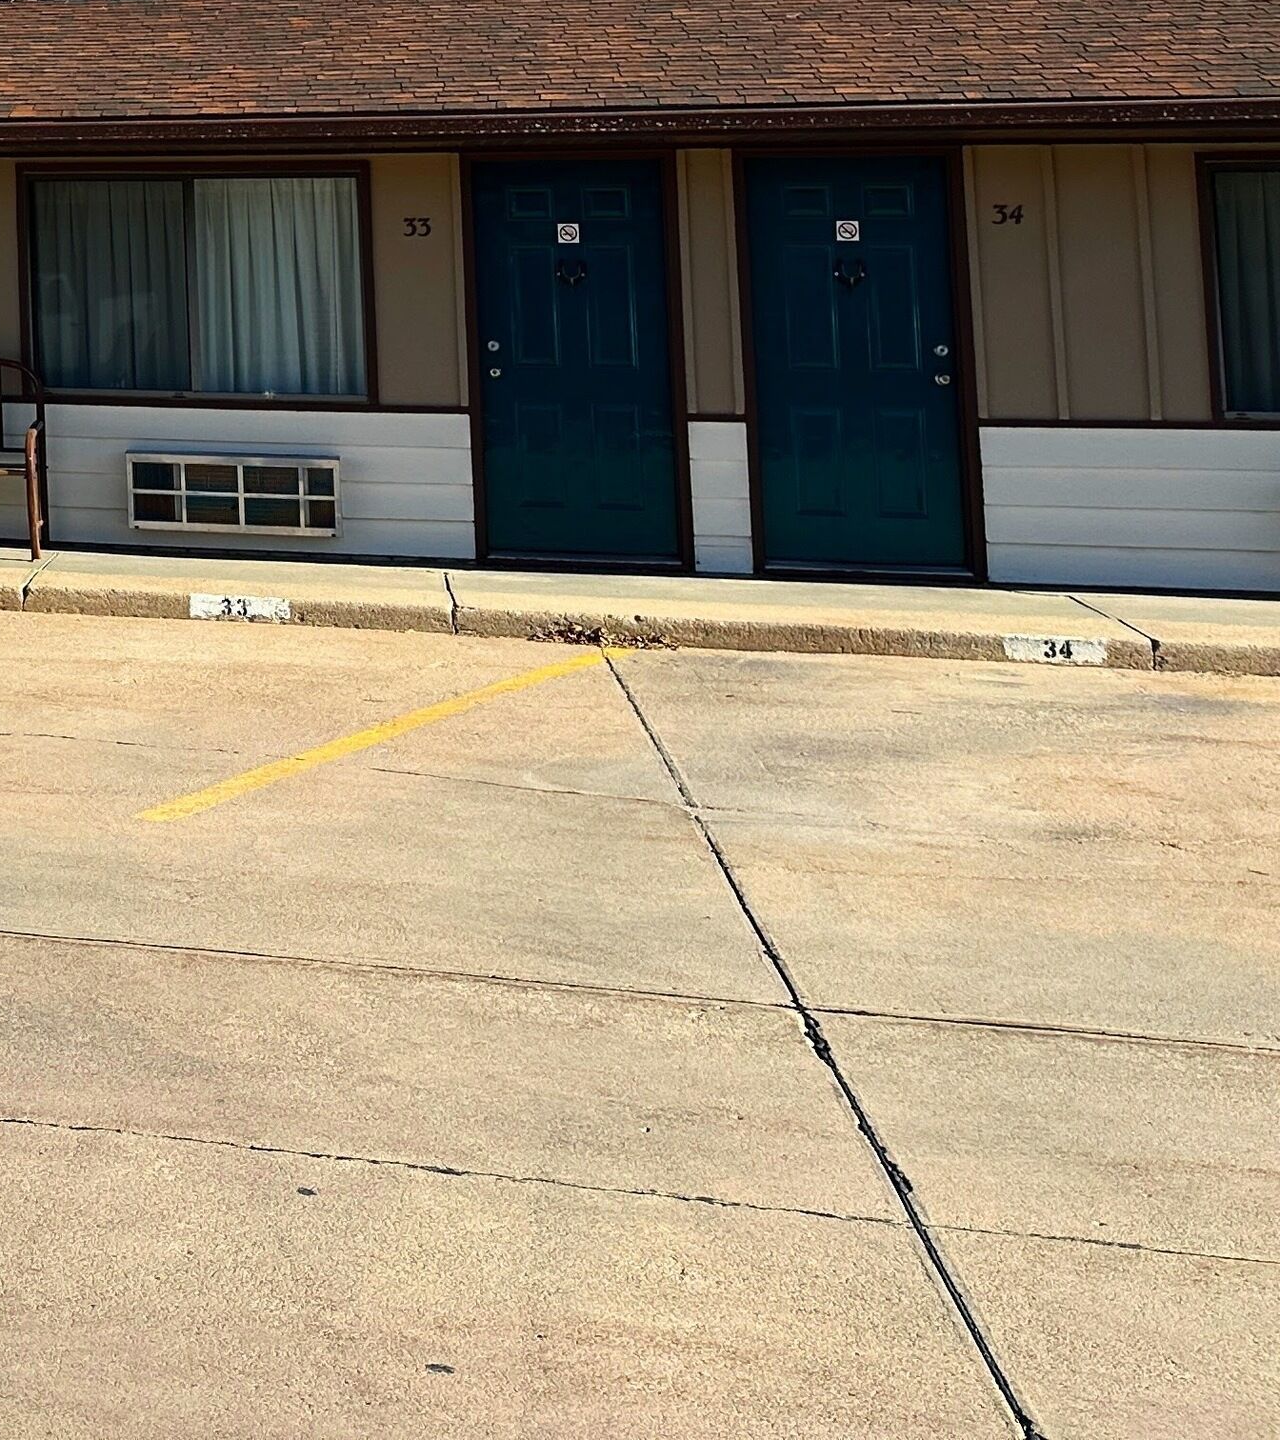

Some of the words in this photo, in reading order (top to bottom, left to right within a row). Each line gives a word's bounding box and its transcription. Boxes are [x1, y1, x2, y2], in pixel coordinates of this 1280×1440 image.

[991, 204, 1024, 225] 34
[403, 217, 431, 237] 33
[221, 598, 247, 616] 33
[1043, 639, 1073, 659] 34
